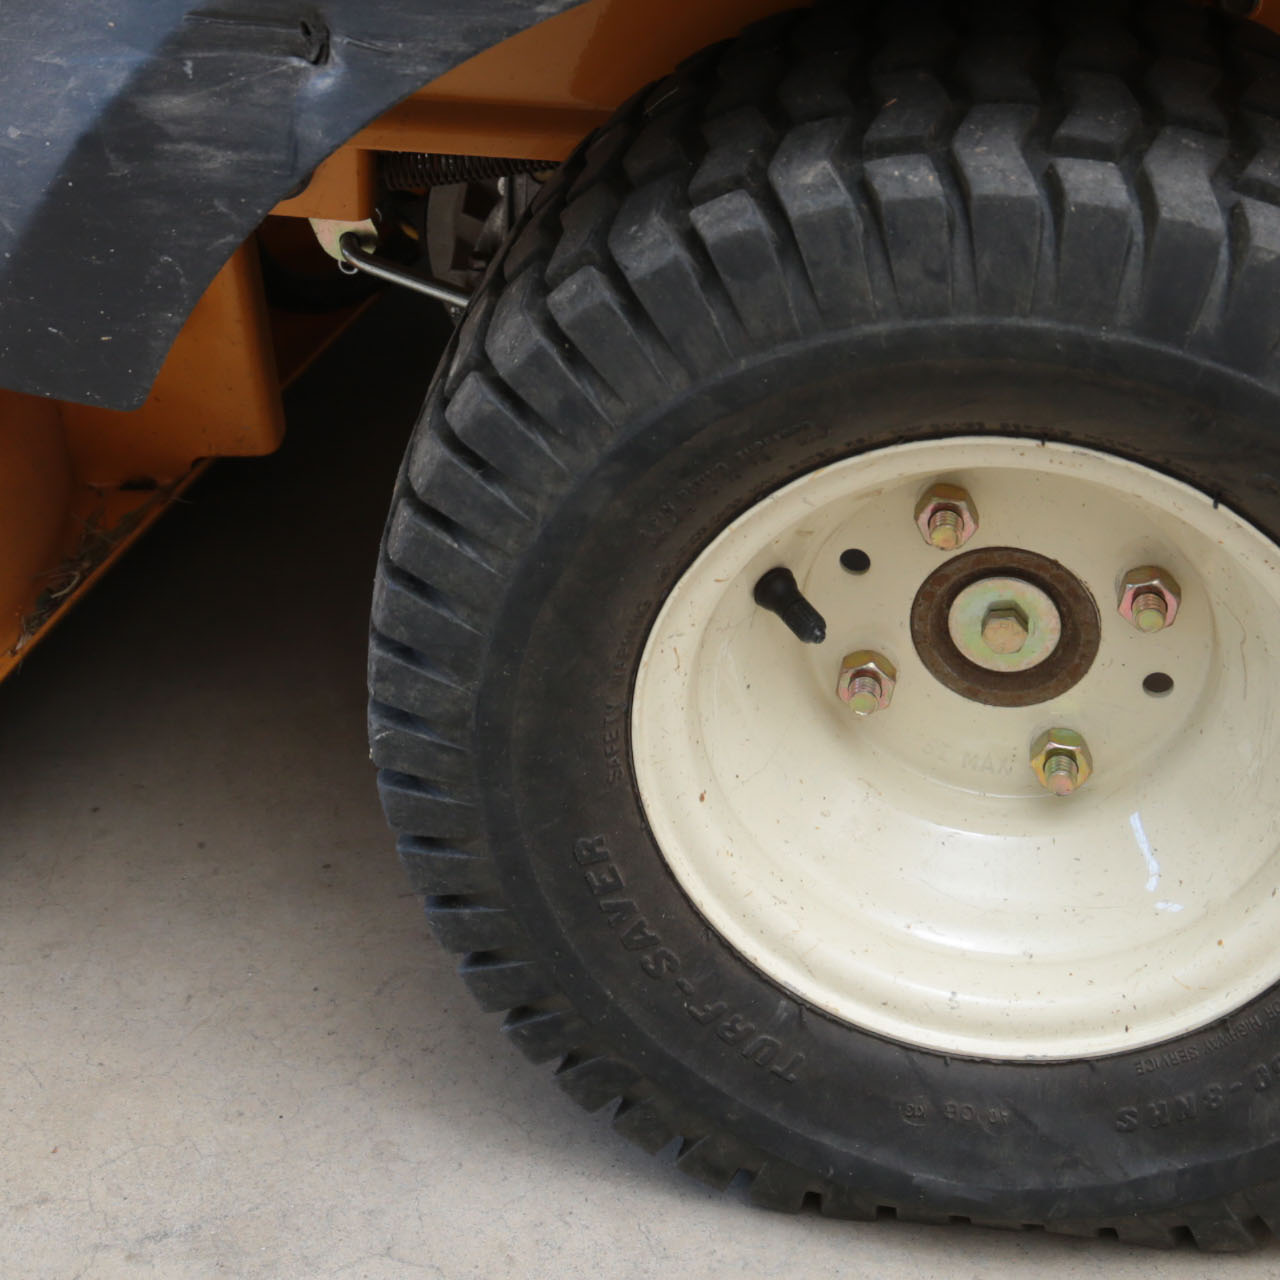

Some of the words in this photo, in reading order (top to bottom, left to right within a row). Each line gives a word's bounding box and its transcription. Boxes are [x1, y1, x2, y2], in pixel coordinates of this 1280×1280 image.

[572, 833, 806, 1083] TURF-SAVER
[1203, 1015, 1263, 1059] HIGHWAY
[1134, 1046, 1200, 1076] SERVICE
